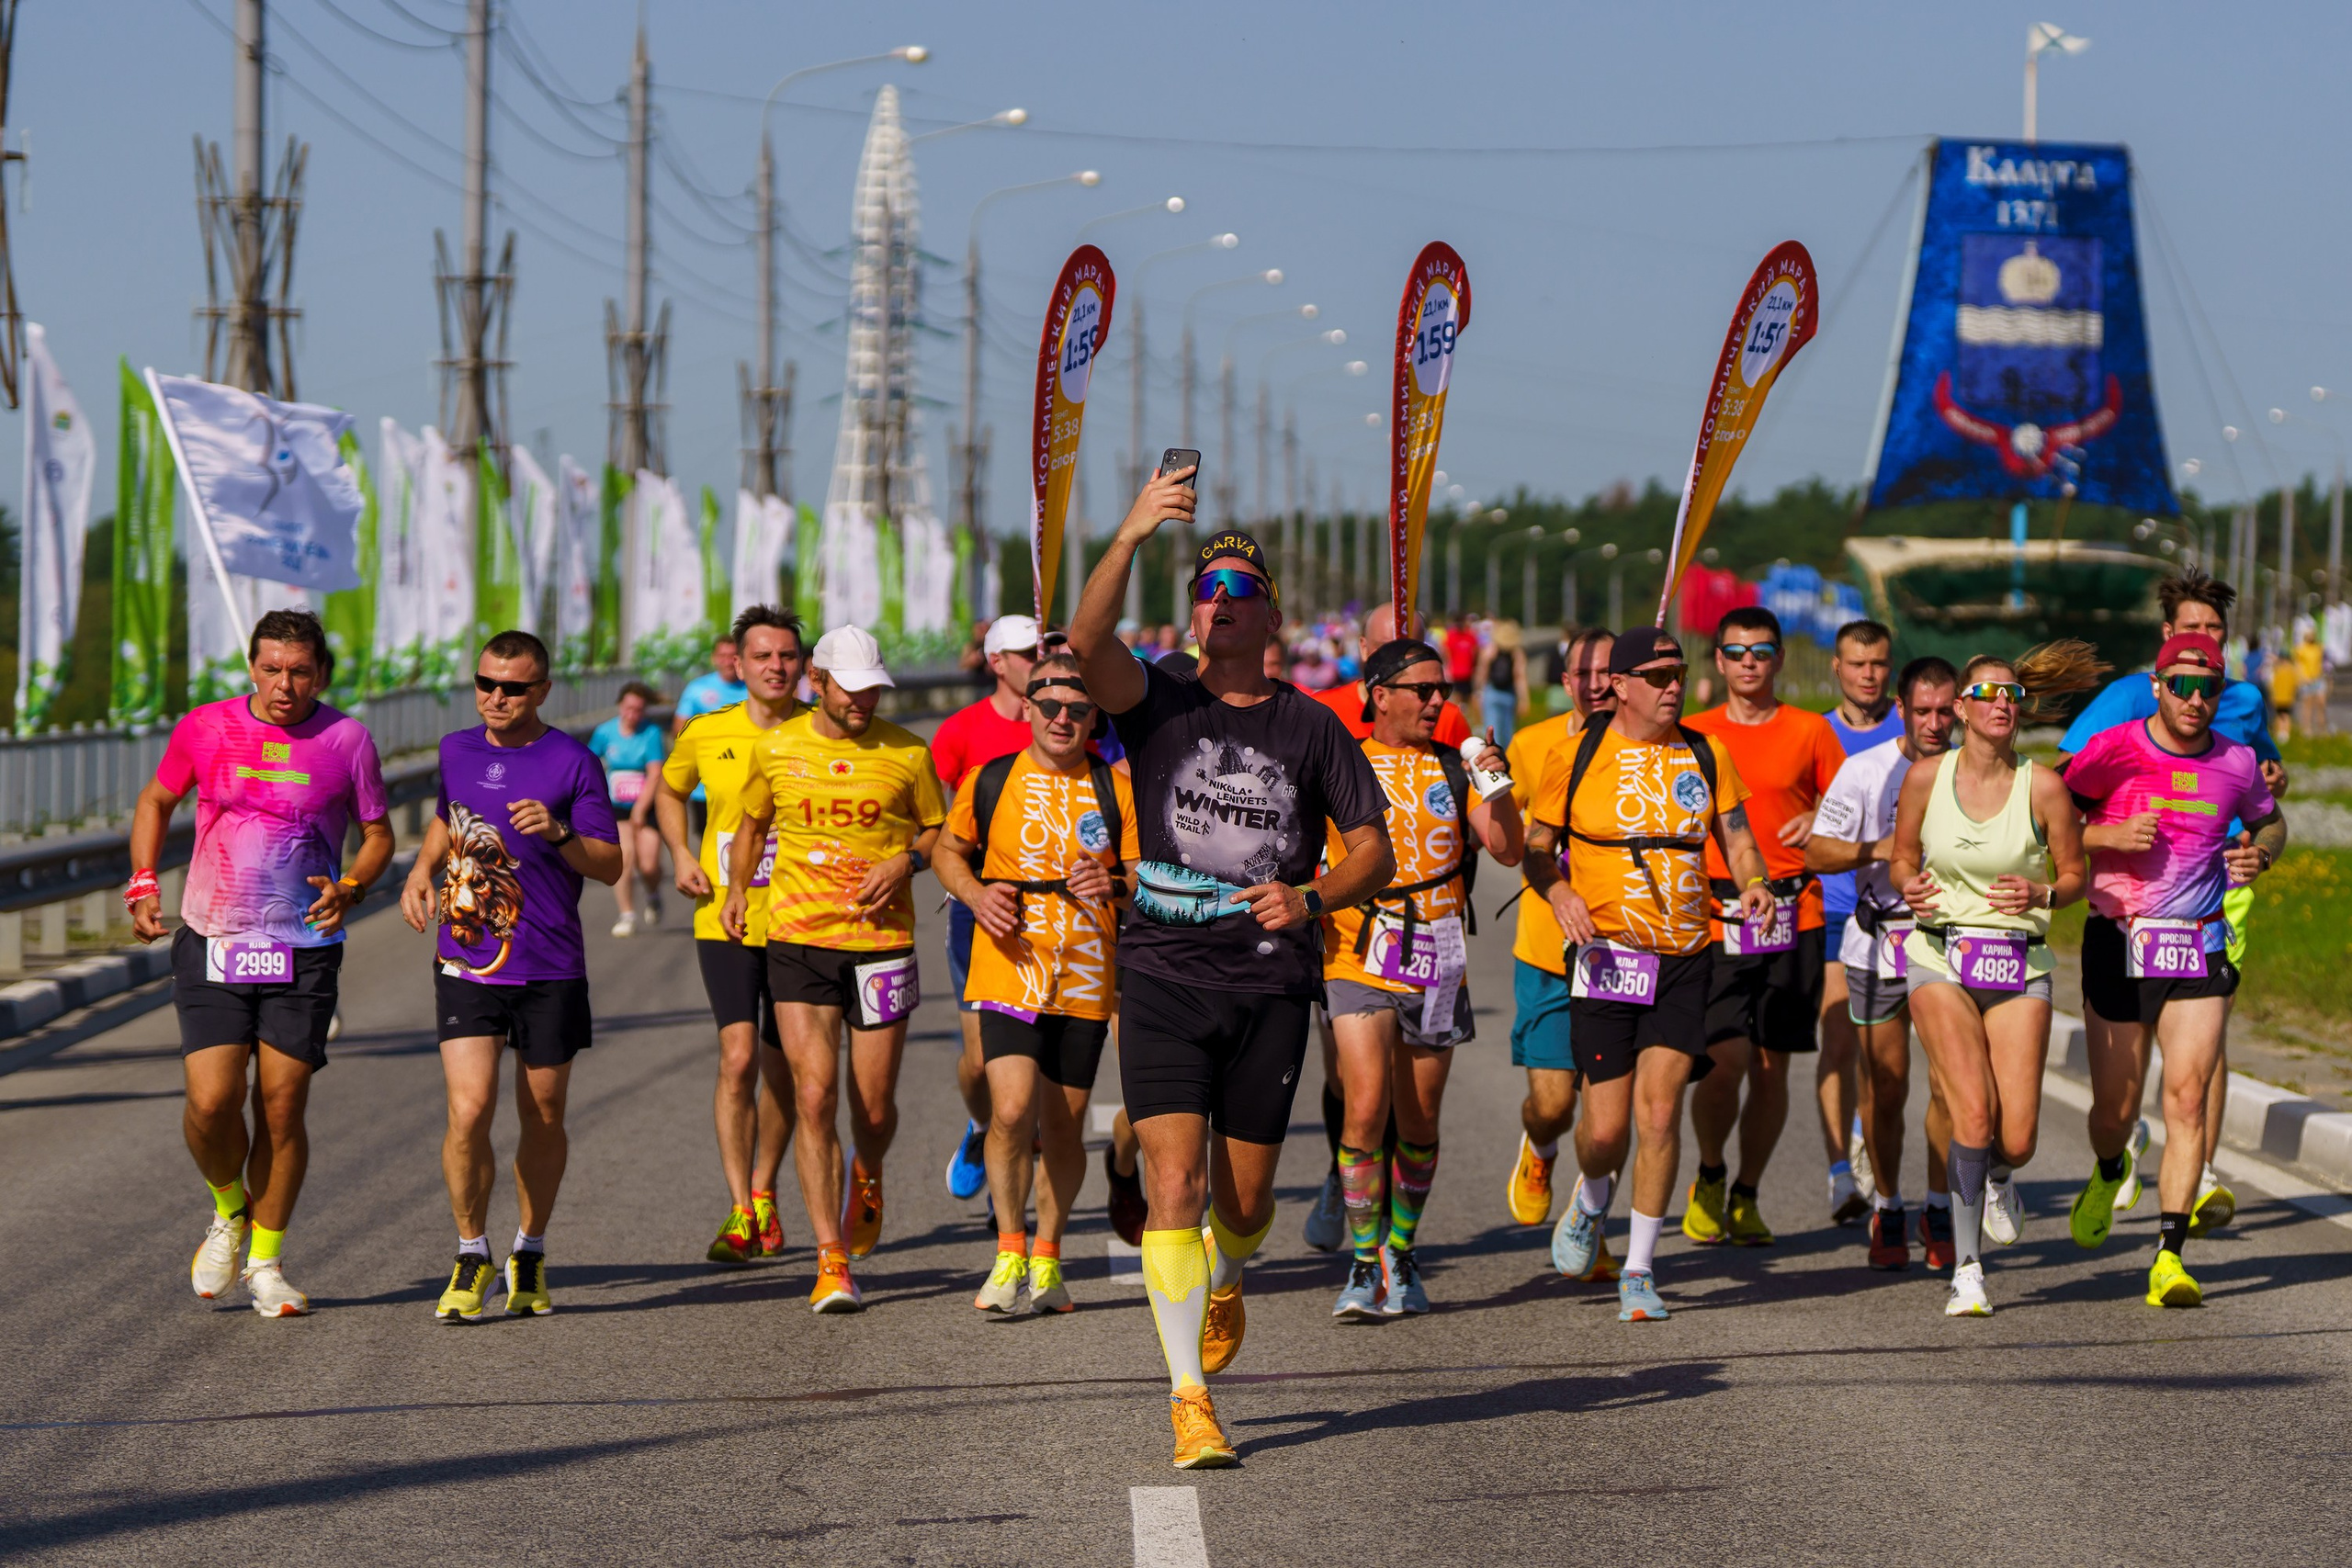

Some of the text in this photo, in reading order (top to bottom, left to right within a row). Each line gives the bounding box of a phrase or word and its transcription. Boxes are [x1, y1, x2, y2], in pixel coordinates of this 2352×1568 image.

[1074, 264, 1105, 294] МАРА
[1722, 398, 1745, 417] 5:38
[1202, 536, 1255, 559] GARVA
[1398, 489, 1408, 635] АЛУЖСКИЙ
[1174, 786, 1281, 830] WINTER
[1216, 792, 1268, 806] LENIVETS
[797, 798, 881, 828] 1:59
[1176, 813, 1200, 826] WILD
[1175, 820, 1201, 835] TRAIL
[1983, 943, 2013, 956] КАРИНА
[2159, 932, 2193, 945] ЯРОСЛАВ
[235, 951, 285, 976] 2999
[1397, 952, 1440, 981] 261
[1614, 956, 1639, 969] ИЛЬЯ
[1971, 957, 2019, 984] 4982
[2154, 945, 2200, 972] 4973
[1599, 967, 1650, 998] 5050
[887, 980, 918, 1013] 3068
